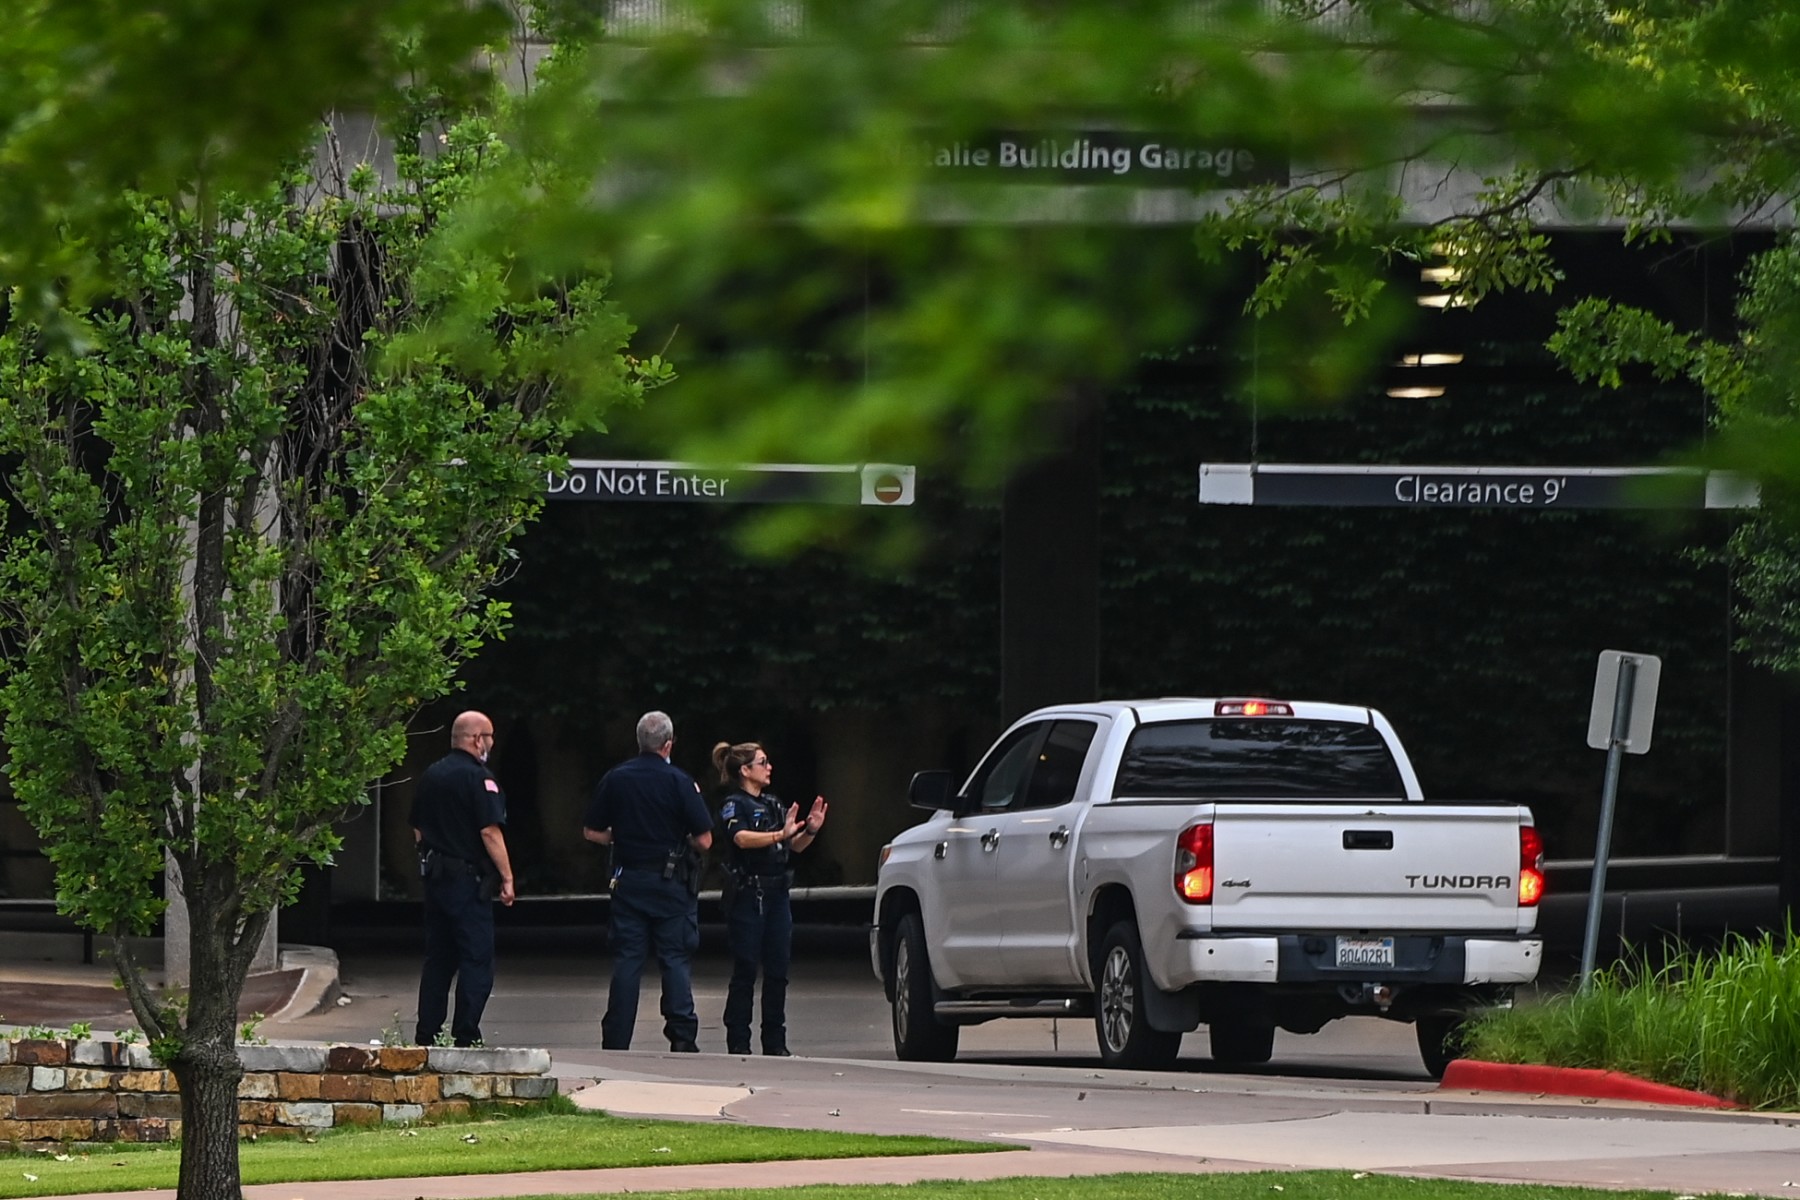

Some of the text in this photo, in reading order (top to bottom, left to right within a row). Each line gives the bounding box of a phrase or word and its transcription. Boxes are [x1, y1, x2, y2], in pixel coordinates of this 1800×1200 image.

[999, 139, 1131, 174] Building
[1139, 143, 1255, 177] Garage
[547, 468, 730, 497] Do Not Enter
[1395, 475, 1566, 504] Clearance 9'
[1405, 875, 1511, 889] TUNDRA
